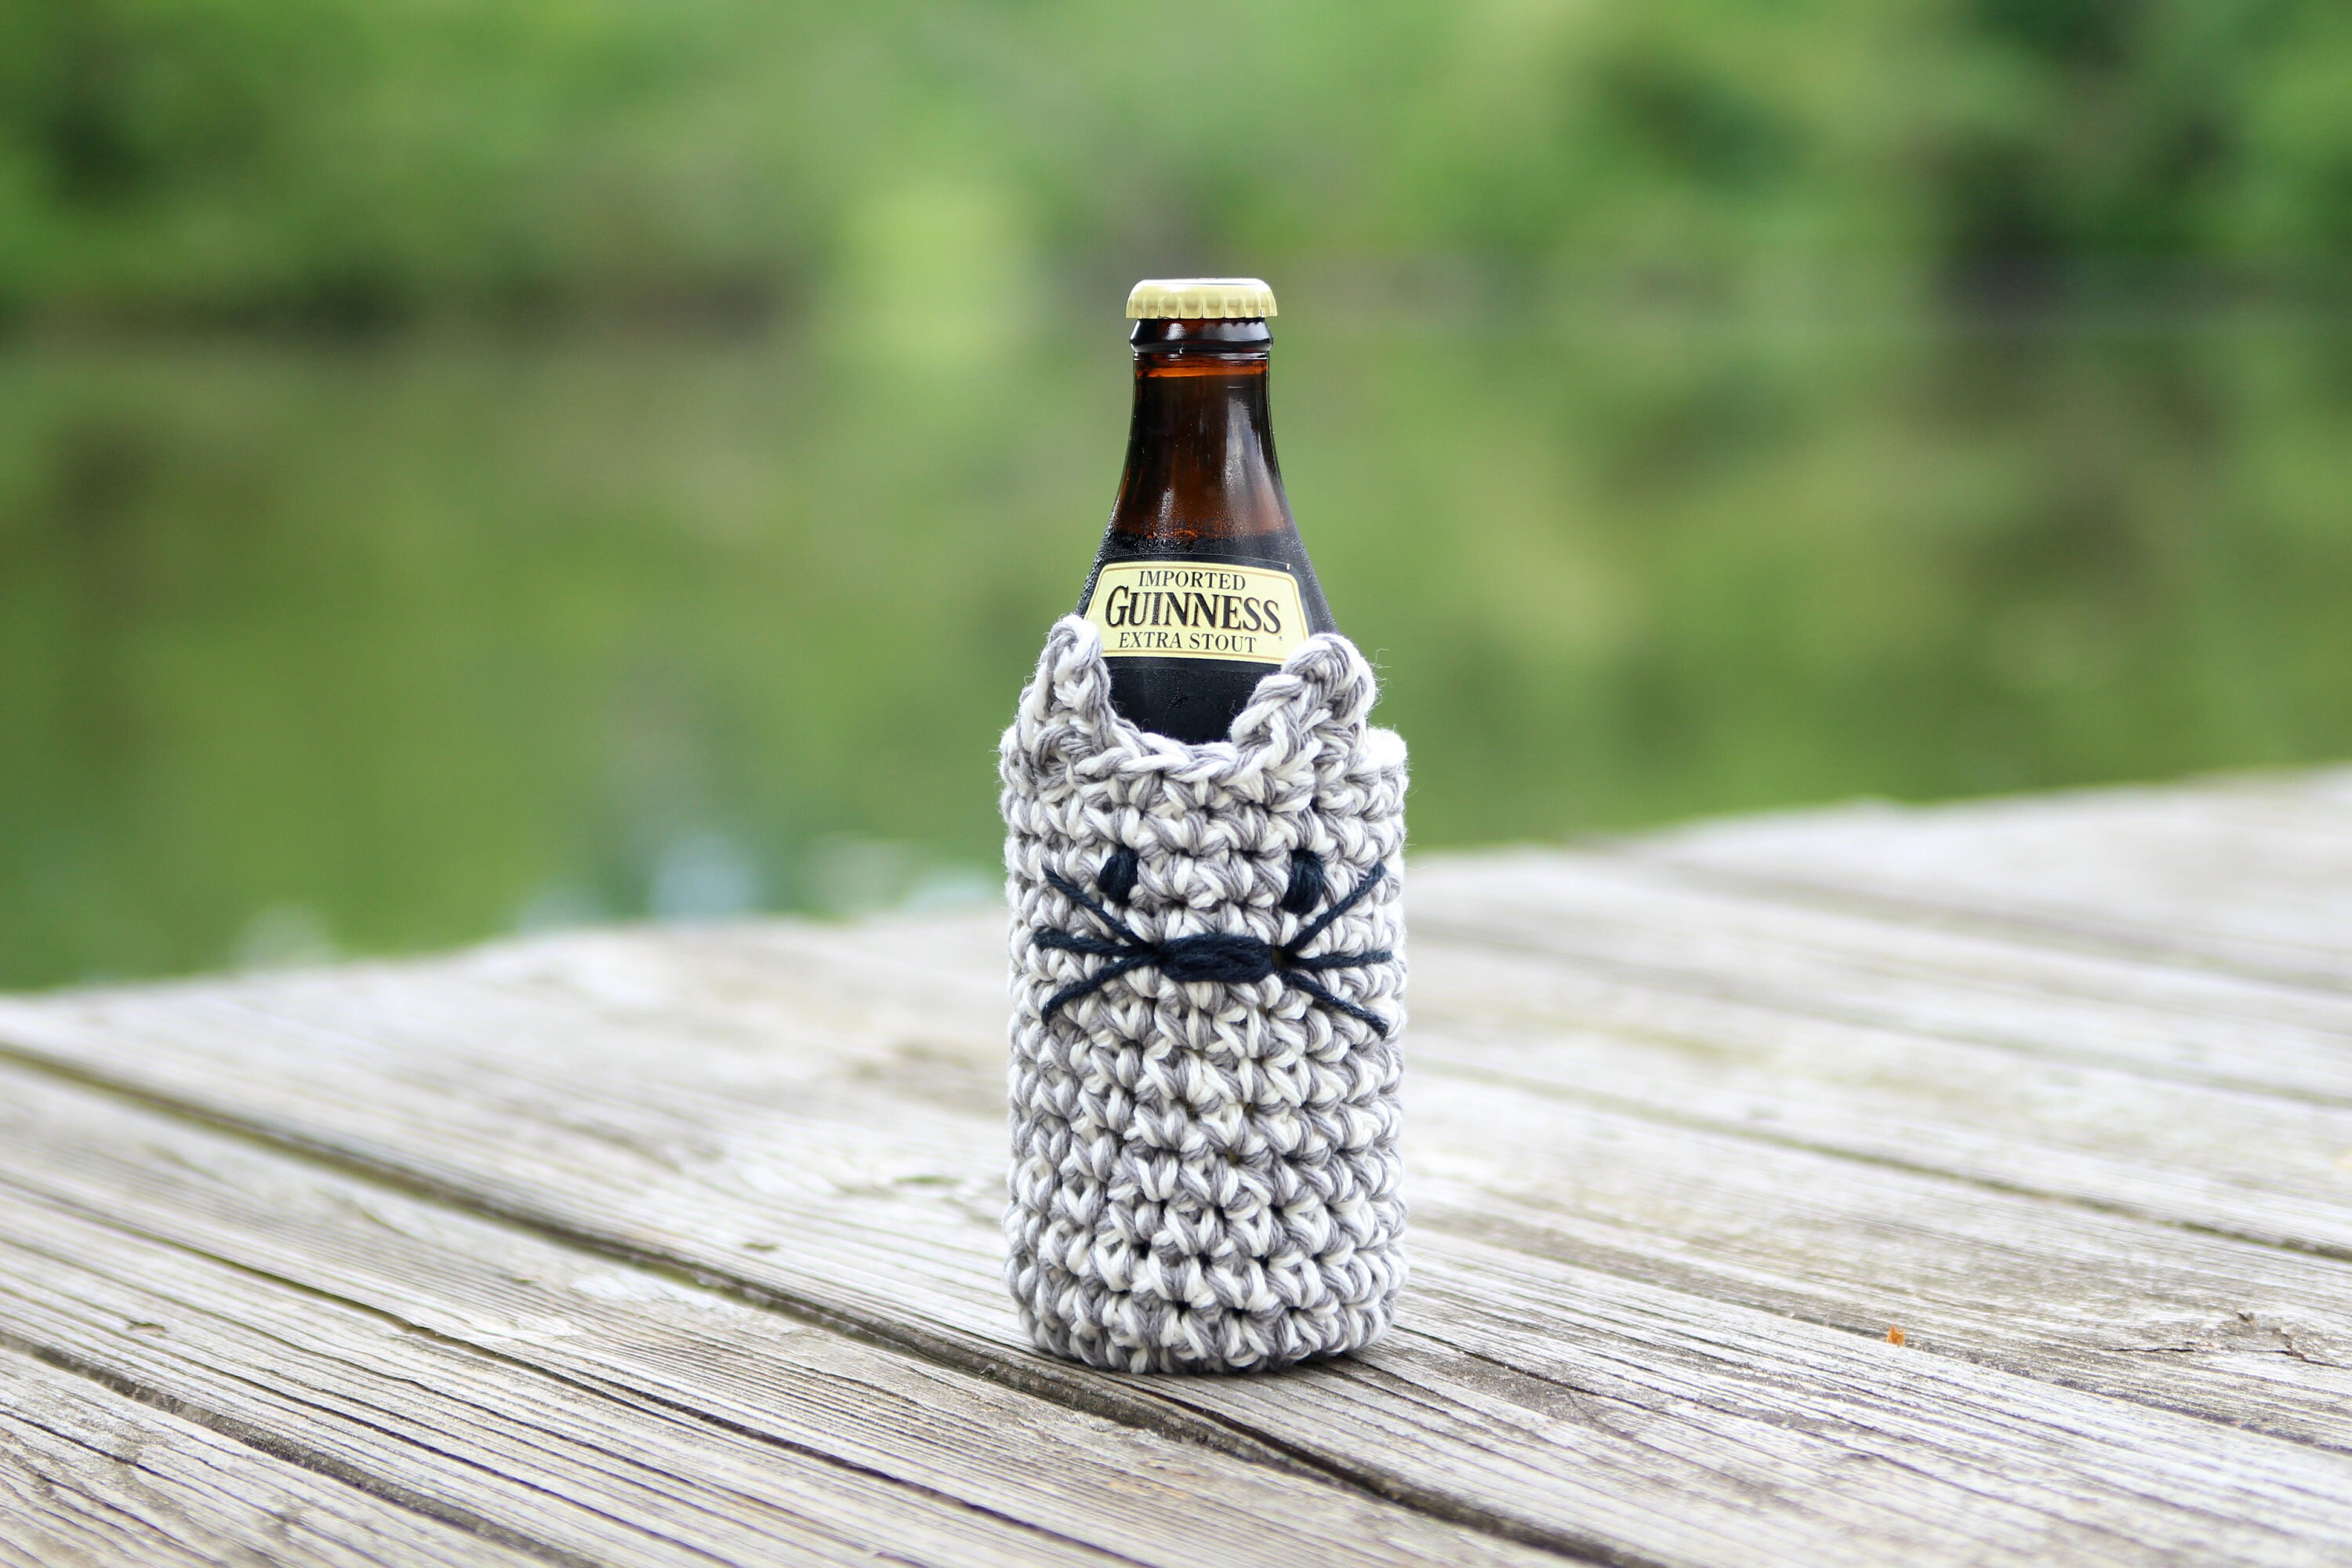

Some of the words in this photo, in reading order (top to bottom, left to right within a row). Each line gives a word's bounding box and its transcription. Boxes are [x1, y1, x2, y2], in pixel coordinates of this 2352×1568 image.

[1138, 571, 1246, 590] IMPORTED
[1105, 585, 1281, 634] GUINNESS
[1119, 632, 1182, 649] EXTRA
[1189, 633, 1257, 653] STOUT
